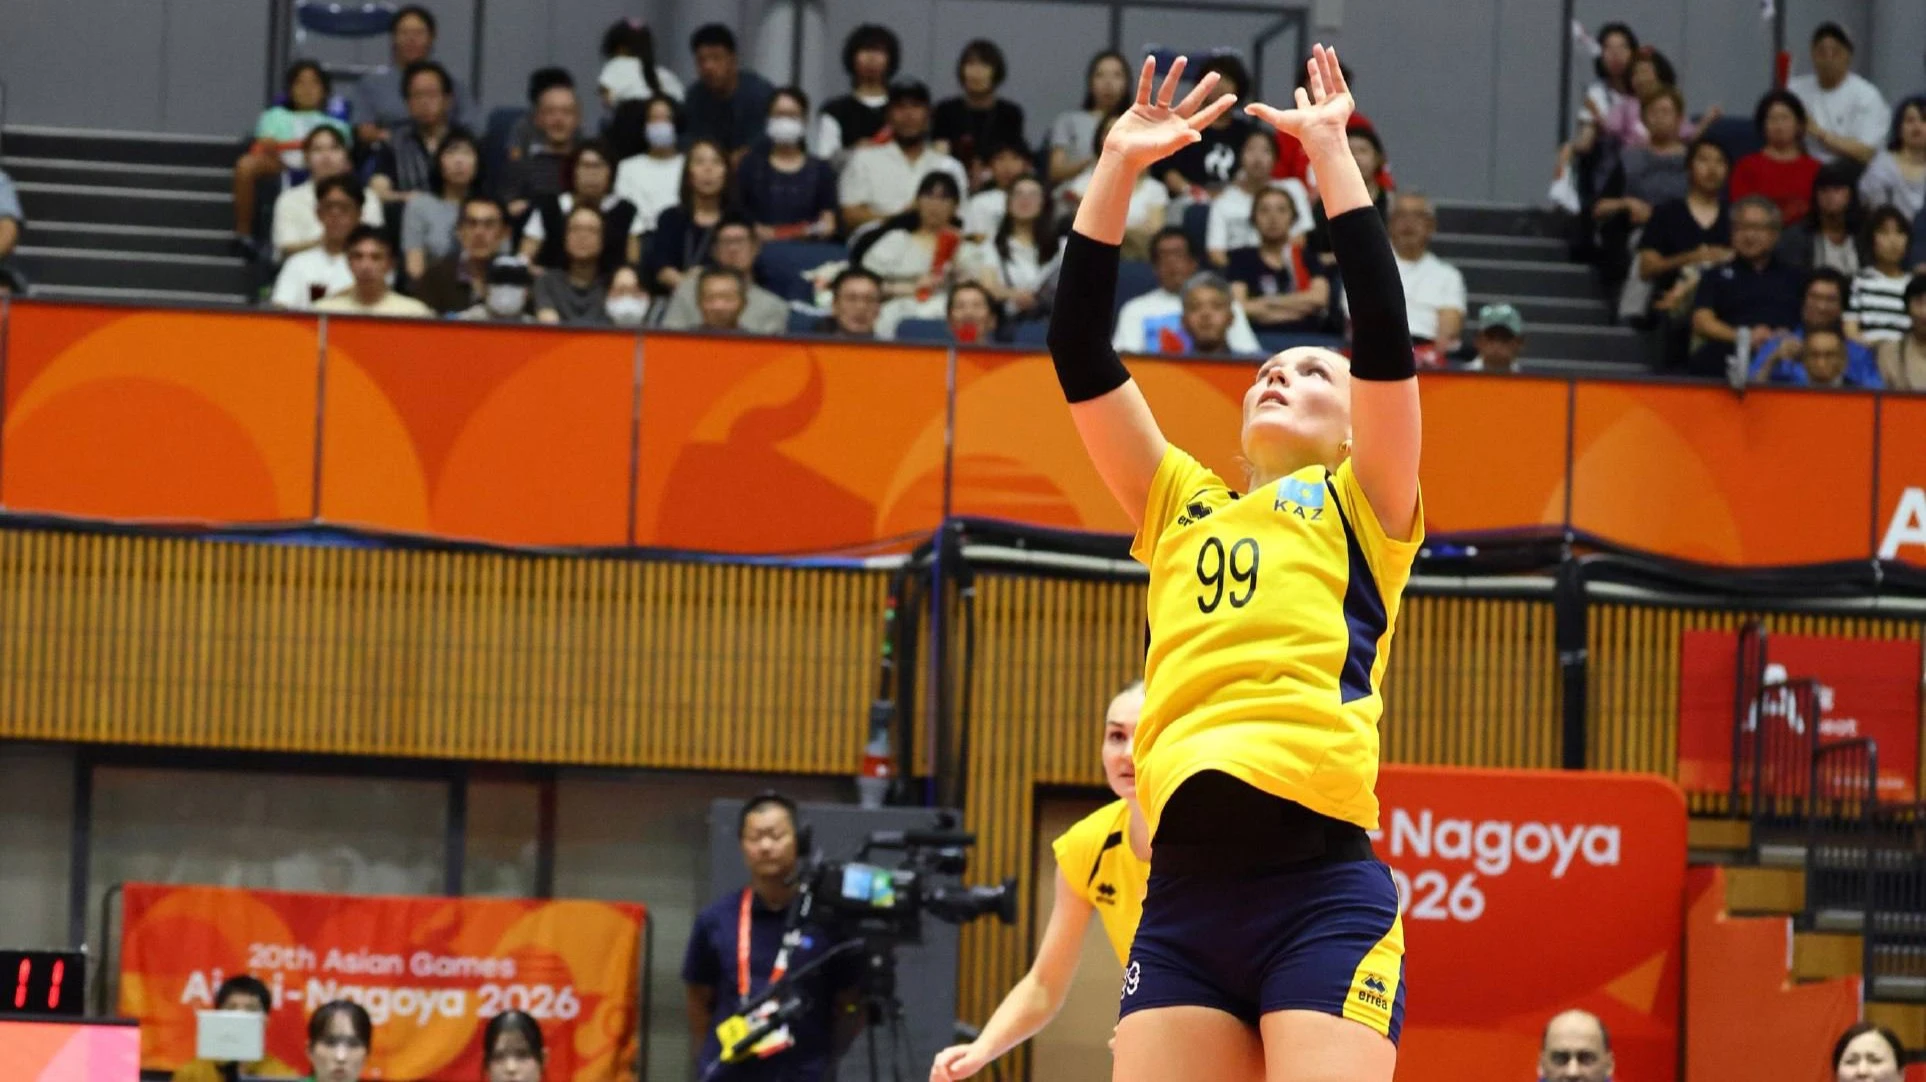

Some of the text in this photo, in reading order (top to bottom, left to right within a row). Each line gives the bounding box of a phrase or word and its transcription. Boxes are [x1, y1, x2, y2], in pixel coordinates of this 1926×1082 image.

[1274, 499, 1323, 520] KAZ
[1197, 536, 1260, 614] 99
[248, 942, 516, 979] 20th Asian Games
[1120, 960, 1141, 1000] 9
[15, 958, 65, 1009] 11
[180, 967, 581, 1027] Aii-Nagoya 2026
